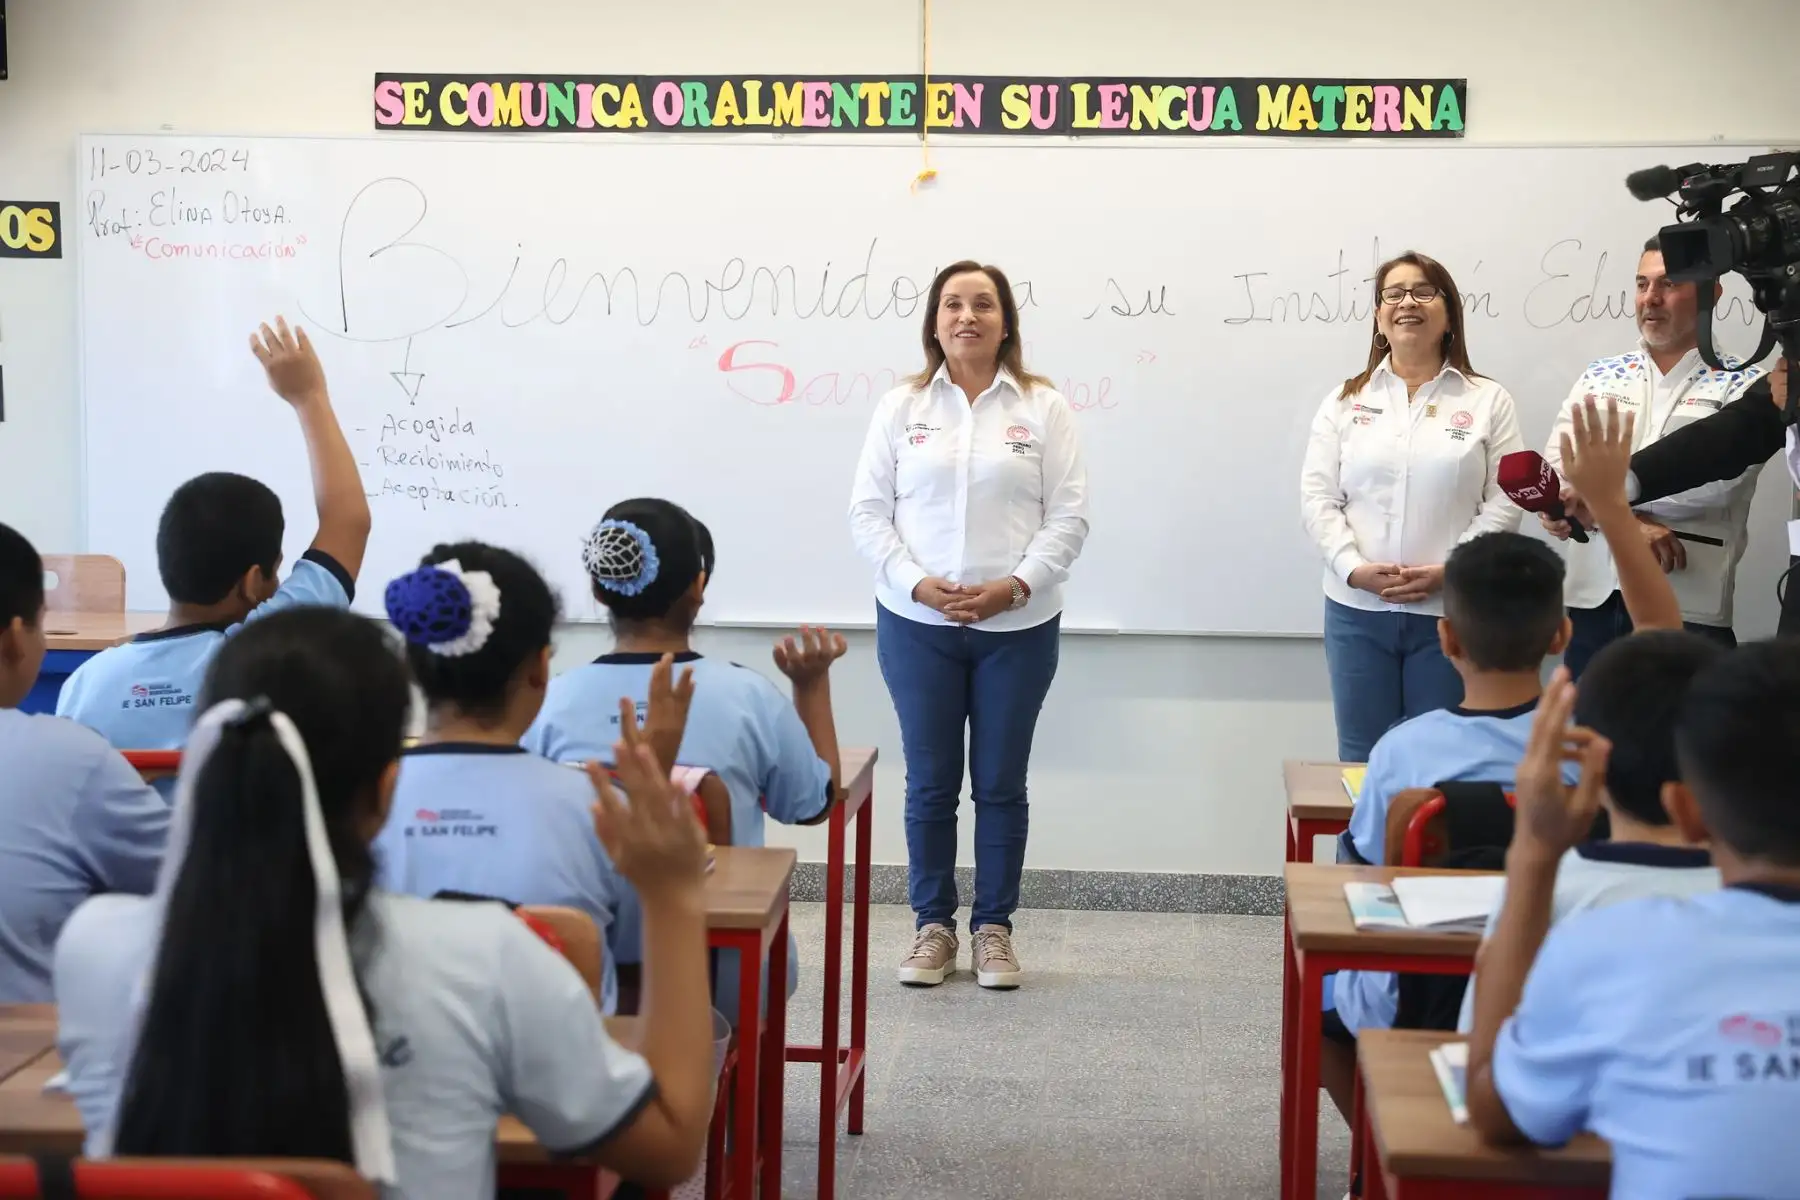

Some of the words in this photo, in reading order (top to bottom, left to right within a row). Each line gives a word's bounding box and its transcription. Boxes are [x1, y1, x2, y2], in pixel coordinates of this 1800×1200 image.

[375, 80, 432, 127] SE
[439, 81, 648, 128] COMUNICA
[652, 80, 917, 127] ORALMENTE
[927, 82, 984, 129] EN
[1000, 83, 1059, 130] SU
[1071, 83, 1242, 131] LENGUA
[1256, 84, 1464, 132] MATERNA
[297, 177, 938, 342] Bienvenido
[1083, 278, 1176, 319] su
[381, 407, 474, 442] Acogida
[377, 444, 504, 478] Recibimiento
[134, 698, 155, 708] SAN
[160, 695, 191, 706] FELIPE
